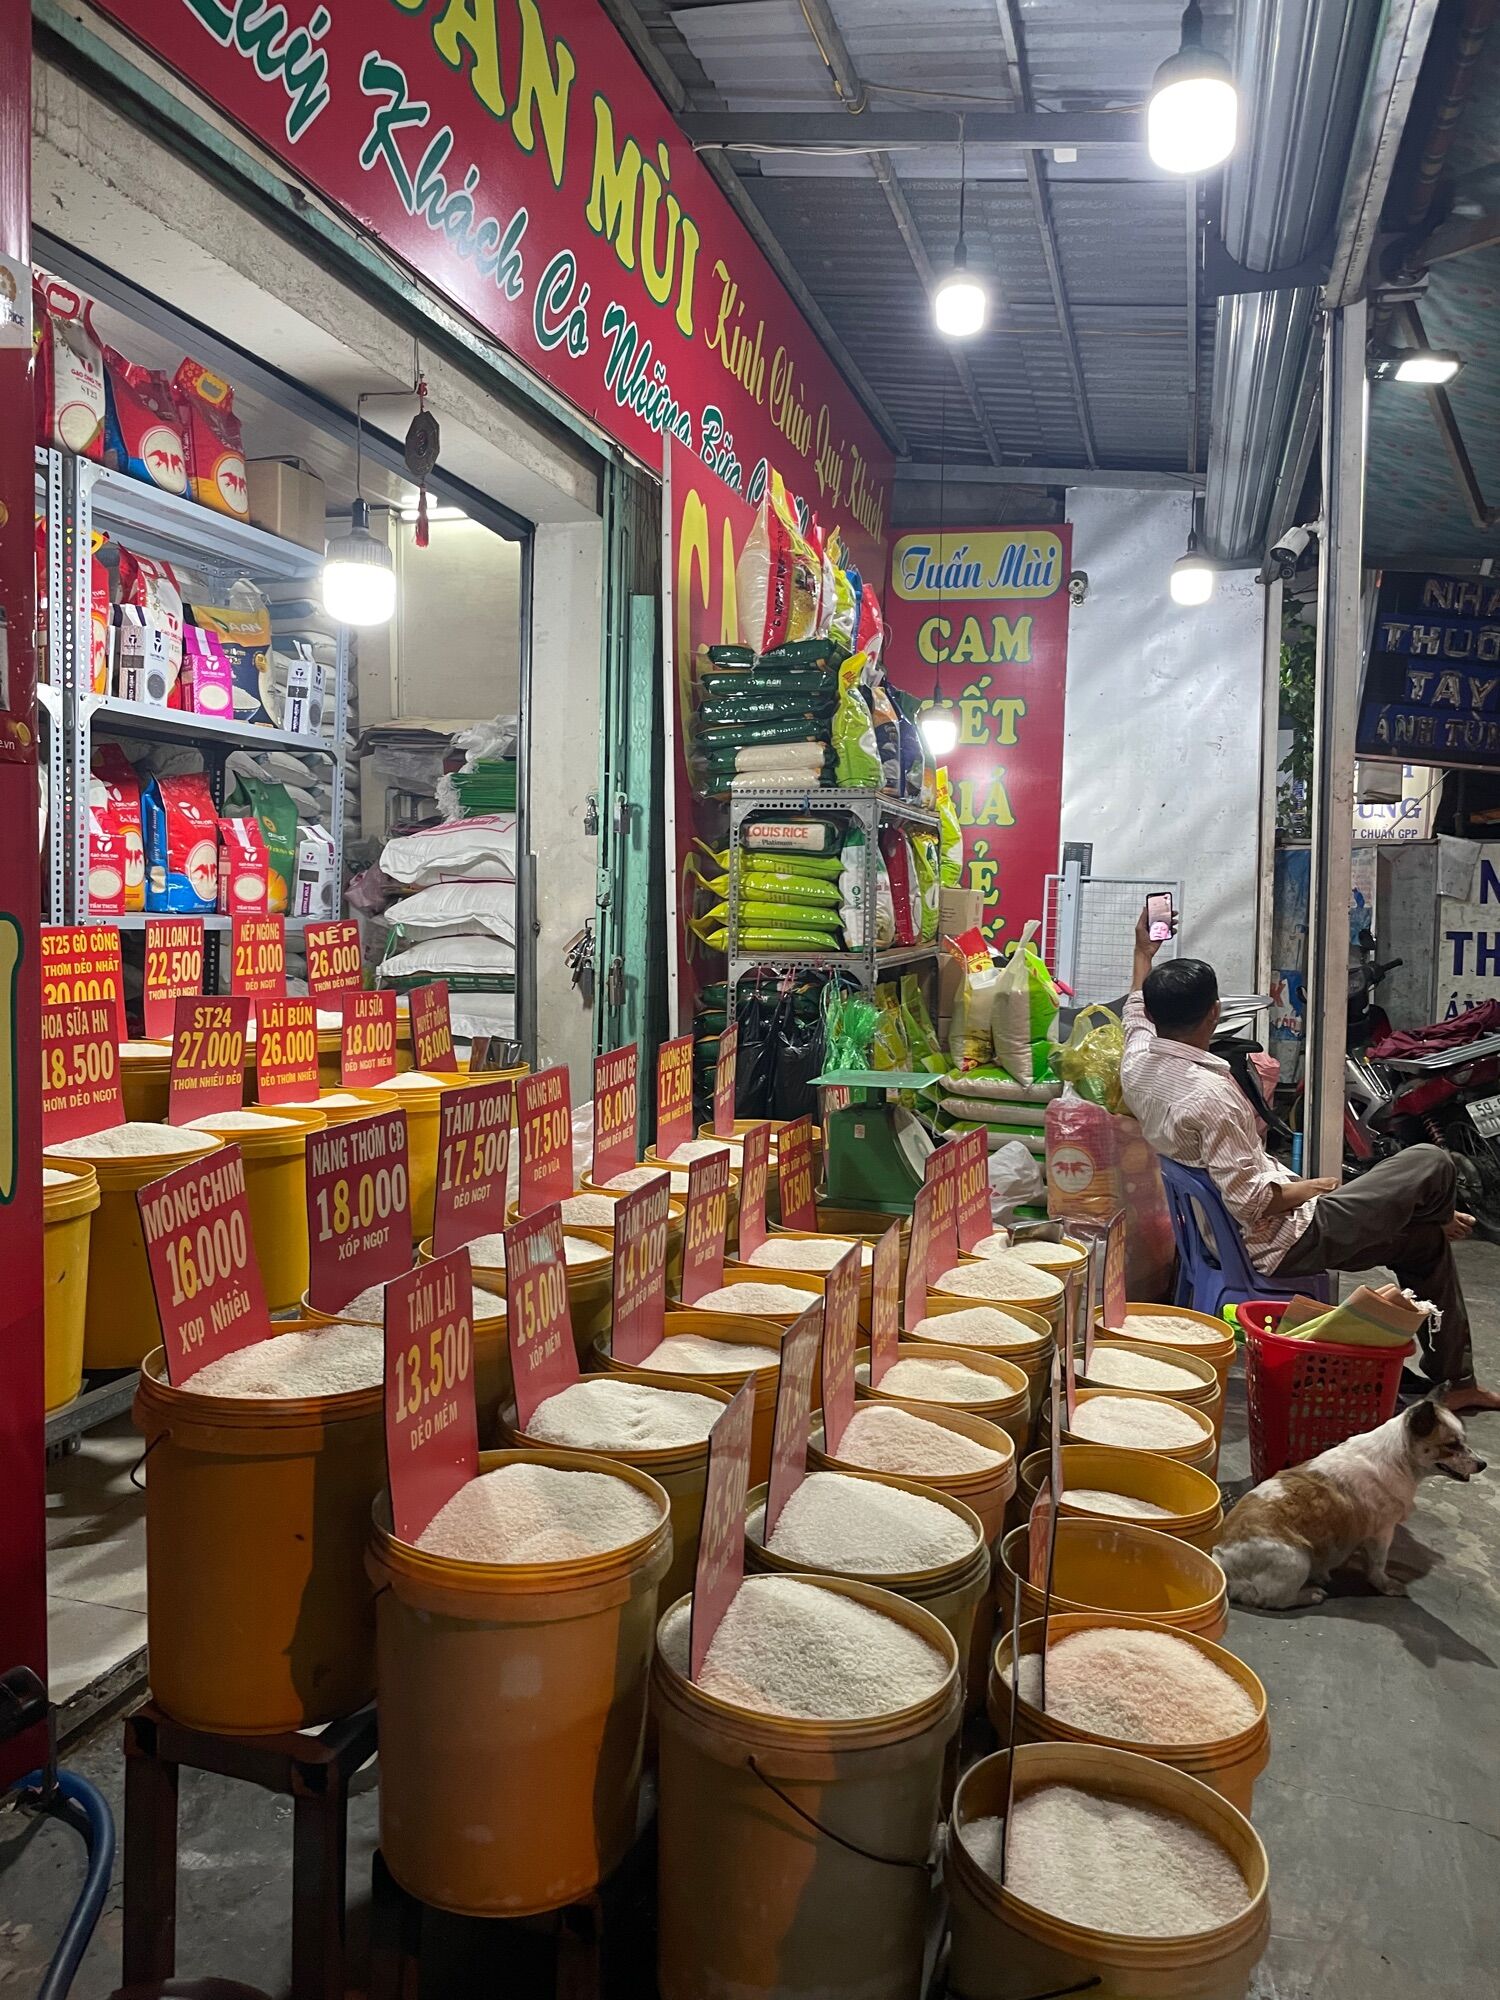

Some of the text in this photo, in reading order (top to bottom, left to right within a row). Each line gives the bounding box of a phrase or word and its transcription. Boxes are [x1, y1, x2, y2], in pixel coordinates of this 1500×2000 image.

[359, 50, 528, 302] Khách
[533, 249, 591, 358] Có
[586, 95, 702, 339] MÙI
[704, 260, 884, 545] Kính Chào Quý Khách
[901, 542, 1055, 590] Tuấn Mùi
[918, 615, 1031, 664] CAM
[921, 676, 1026, 745] ẾT
[948, 766, 1016, 826] IÁ
[748, 827, 808, 838] LOUIS RICE
[1398, 828, 1418, 839] GPP
[42, 928, 119, 955] ST25 GÒ CÔNG
[149, 922, 202, 948] ĐÀI LOAN L1
[308, 923, 357, 947] NẾP
[44, 954, 119, 977] THƠM DẺO NHẤT
[236, 944, 283, 976] 21.000
[310, 945, 360, 979] 26.000
[149, 989, 167, 1001] THƠM
[168, 985, 181, 999] DẺO
[245, 978, 276, 991] DẺO NGỌT
[314, 975, 360, 993] THƠM DẺO NGỌT
[41, 1006, 108, 1039] HOA SỮA HN
[194, 1008, 232, 1029] ST24
[263, 1001, 312, 1029] LÀI BÚN
[355, 994, 383, 1018] LÀI SỮA
[176, 1031, 243, 1069] 27.000
[261, 1029, 315, 1067] 26.000
[346, 1022, 392, 1056] 18.000
[419, 1025, 450, 1067] 26.000
[42, 1040, 114, 1090] 18.500
[173, 1069, 242, 1090] THƠM NHIỀU DẺO
[261, 1070, 317, 1087] DẺO THƠM NHIỀU
[345, 1053, 392, 1072] DẺO NGỌT MỀM
[596, 1059, 608, 1093] ĐÀI
[610, 1058, 627, 1087] LOAN
[43, 1087, 117, 1112] HƠM DẺO NGỌT
[526, 1076, 562, 1111] NÀNG HOA
[660, 1064, 691, 1108] 17.500
[444, 1094, 510, 1137] TÁM XOAN
[597, 1083, 636, 1136] 18.000
[312, 1121, 405, 1177] NÀNG THƠM CĐ
[524, 1107, 568, 1164] 17.500
[441, 1129, 508, 1192] 17.500
[533, 1160, 547, 1181] DẺO
[142, 1158, 245, 1244] MÓNG CHIM
[317, 1163, 407, 1242] 18.000
[453, 1184, 490, 1209] DẺO NGỌT
[958, 1158, 986, 1208] 16.000
[642, 1186, 669, 1229] THƠM
[687, 1192, 727, 1251] 15.500
[165, 1209, 247, 1307] 16.000
[338, 1227, 389, 1261] XỐP NGỌT
[617, 1223, 666, 1299] 14.000
[211, 1279, 250, 1334] Nhiều
[407, 1265, 456, 1334] TẤM LÀI
[515, 1260, 566, 1347] 15.000
[396, 1316, 469, 1424] 13.500
[529, 1327, 561, 1371] XỐP MỀM
[410, 1395, 458, 1451] DẺO MỀM
